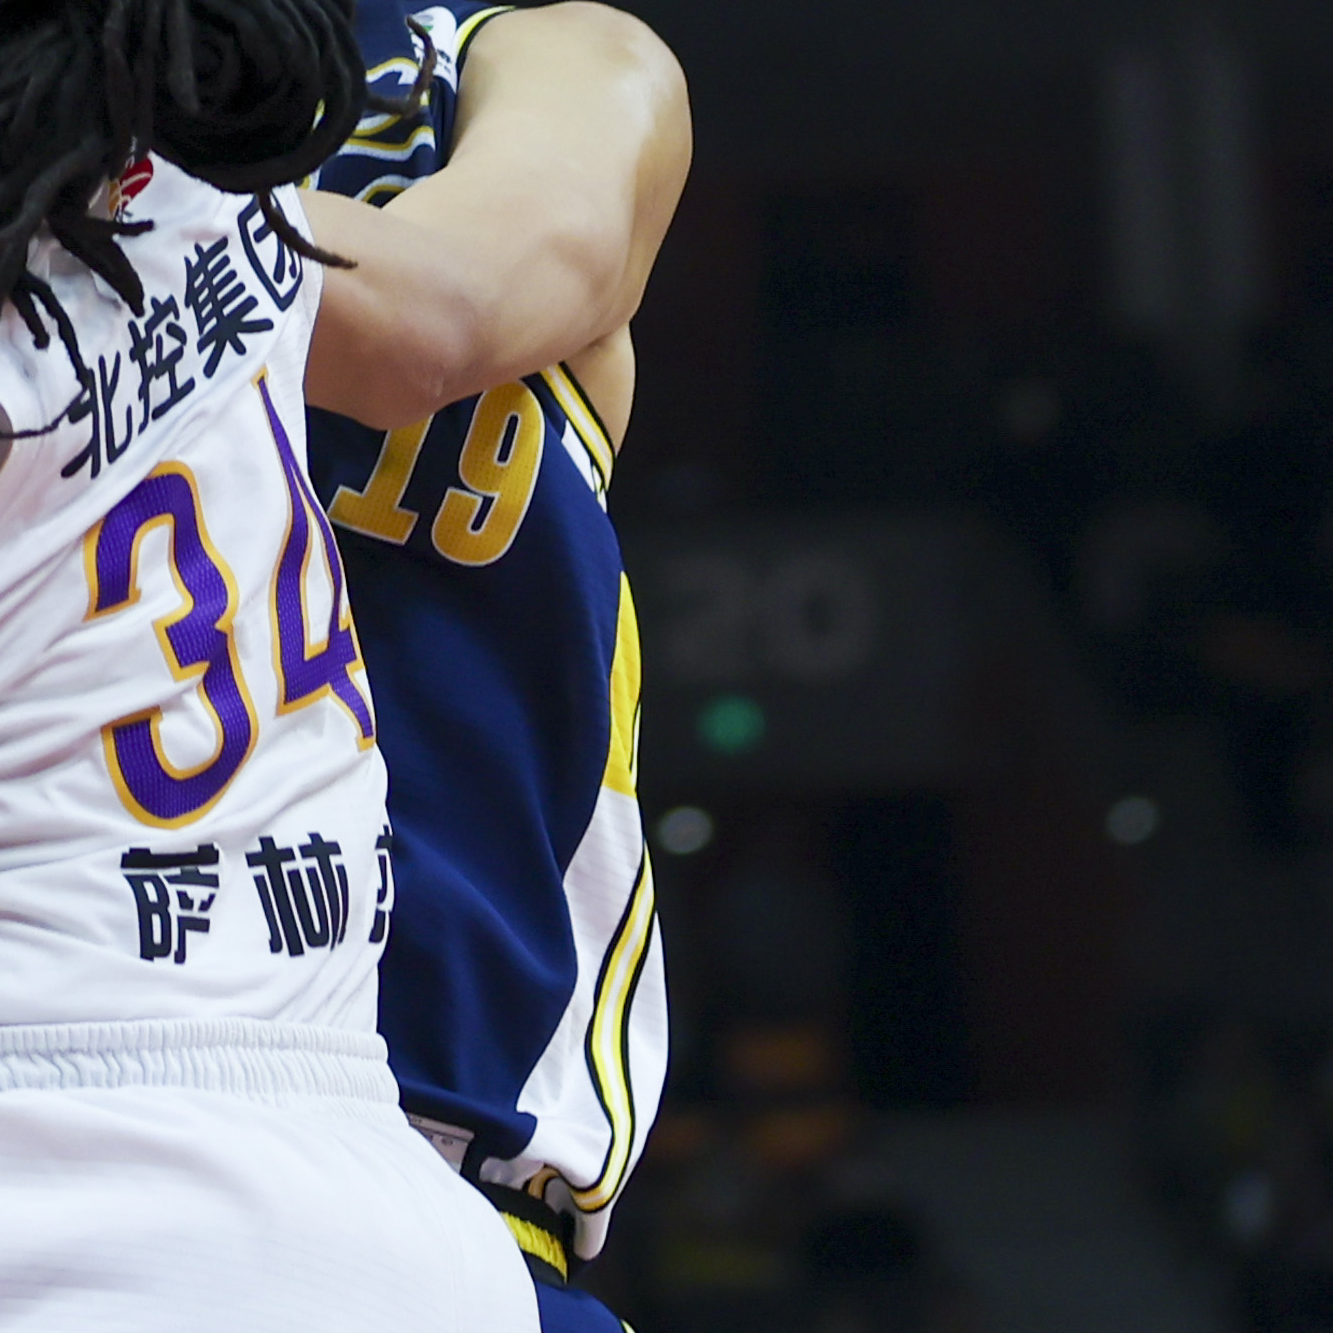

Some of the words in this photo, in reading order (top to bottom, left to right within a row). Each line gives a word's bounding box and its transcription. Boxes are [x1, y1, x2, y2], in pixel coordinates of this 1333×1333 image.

[60, 189, 304, 480] 北控集团
[326, 377, 546, 567] 19
[82, 366, 378, 831] 34
